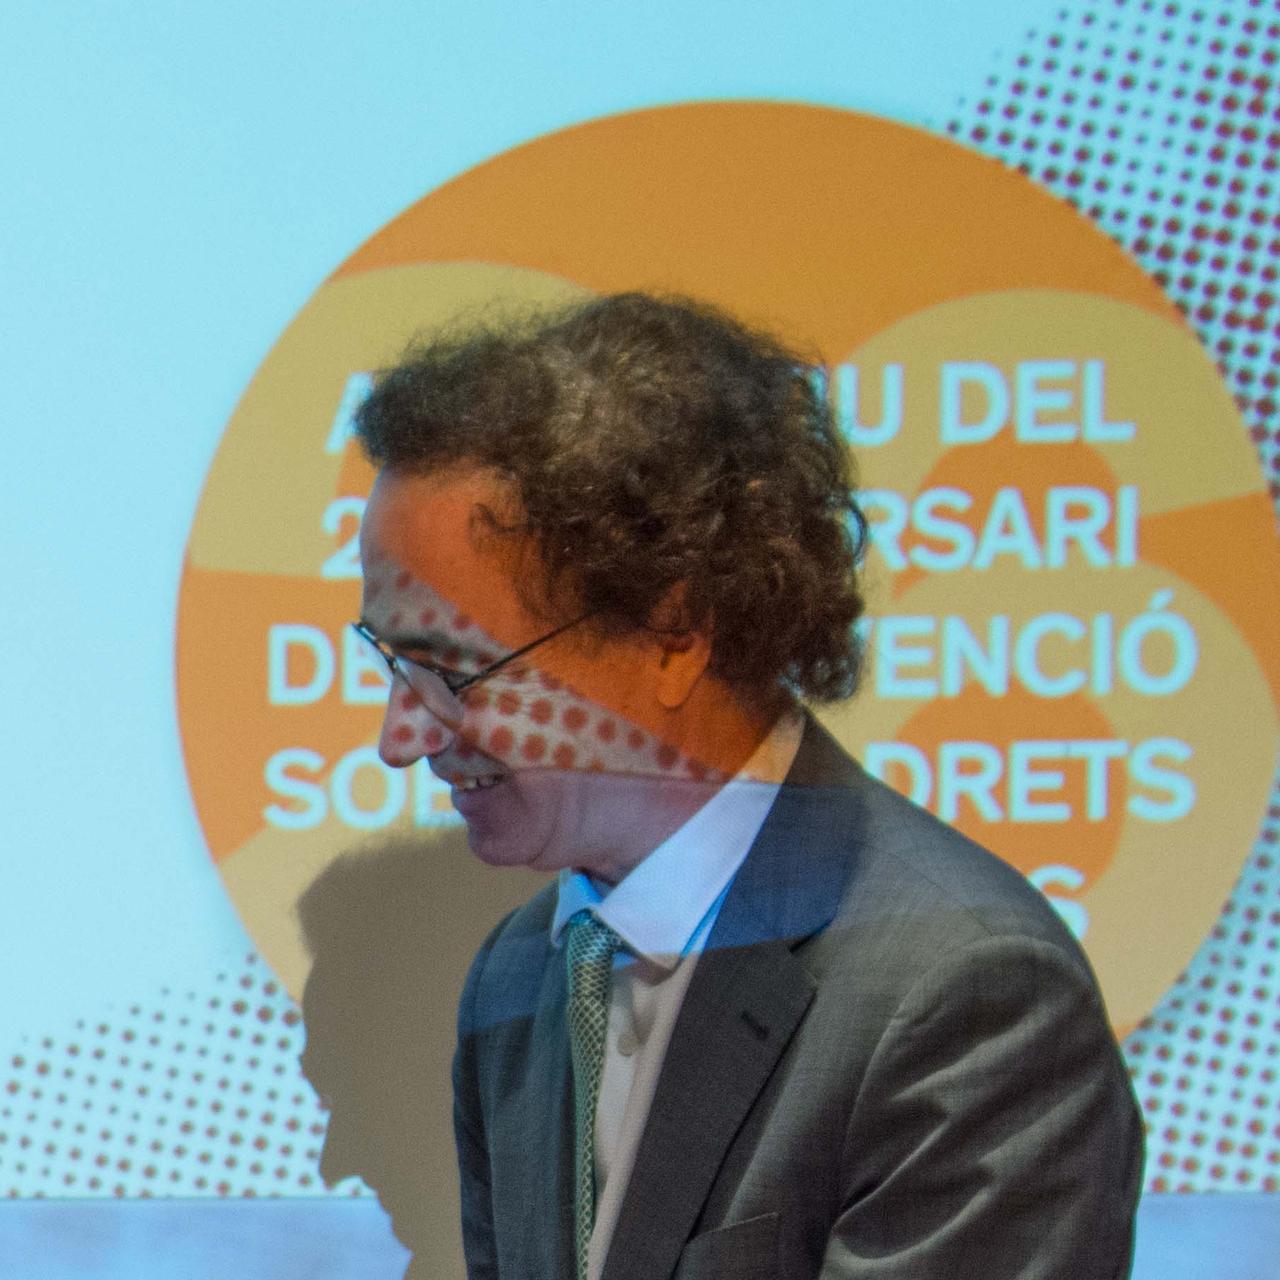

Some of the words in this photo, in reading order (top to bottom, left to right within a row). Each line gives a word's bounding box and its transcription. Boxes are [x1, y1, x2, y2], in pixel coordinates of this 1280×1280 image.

[940, 358, 1138, 446] DEL
[854, 588, 1200, 698] ENCIÓ
[864, 736, 1198, 823] DRETS
